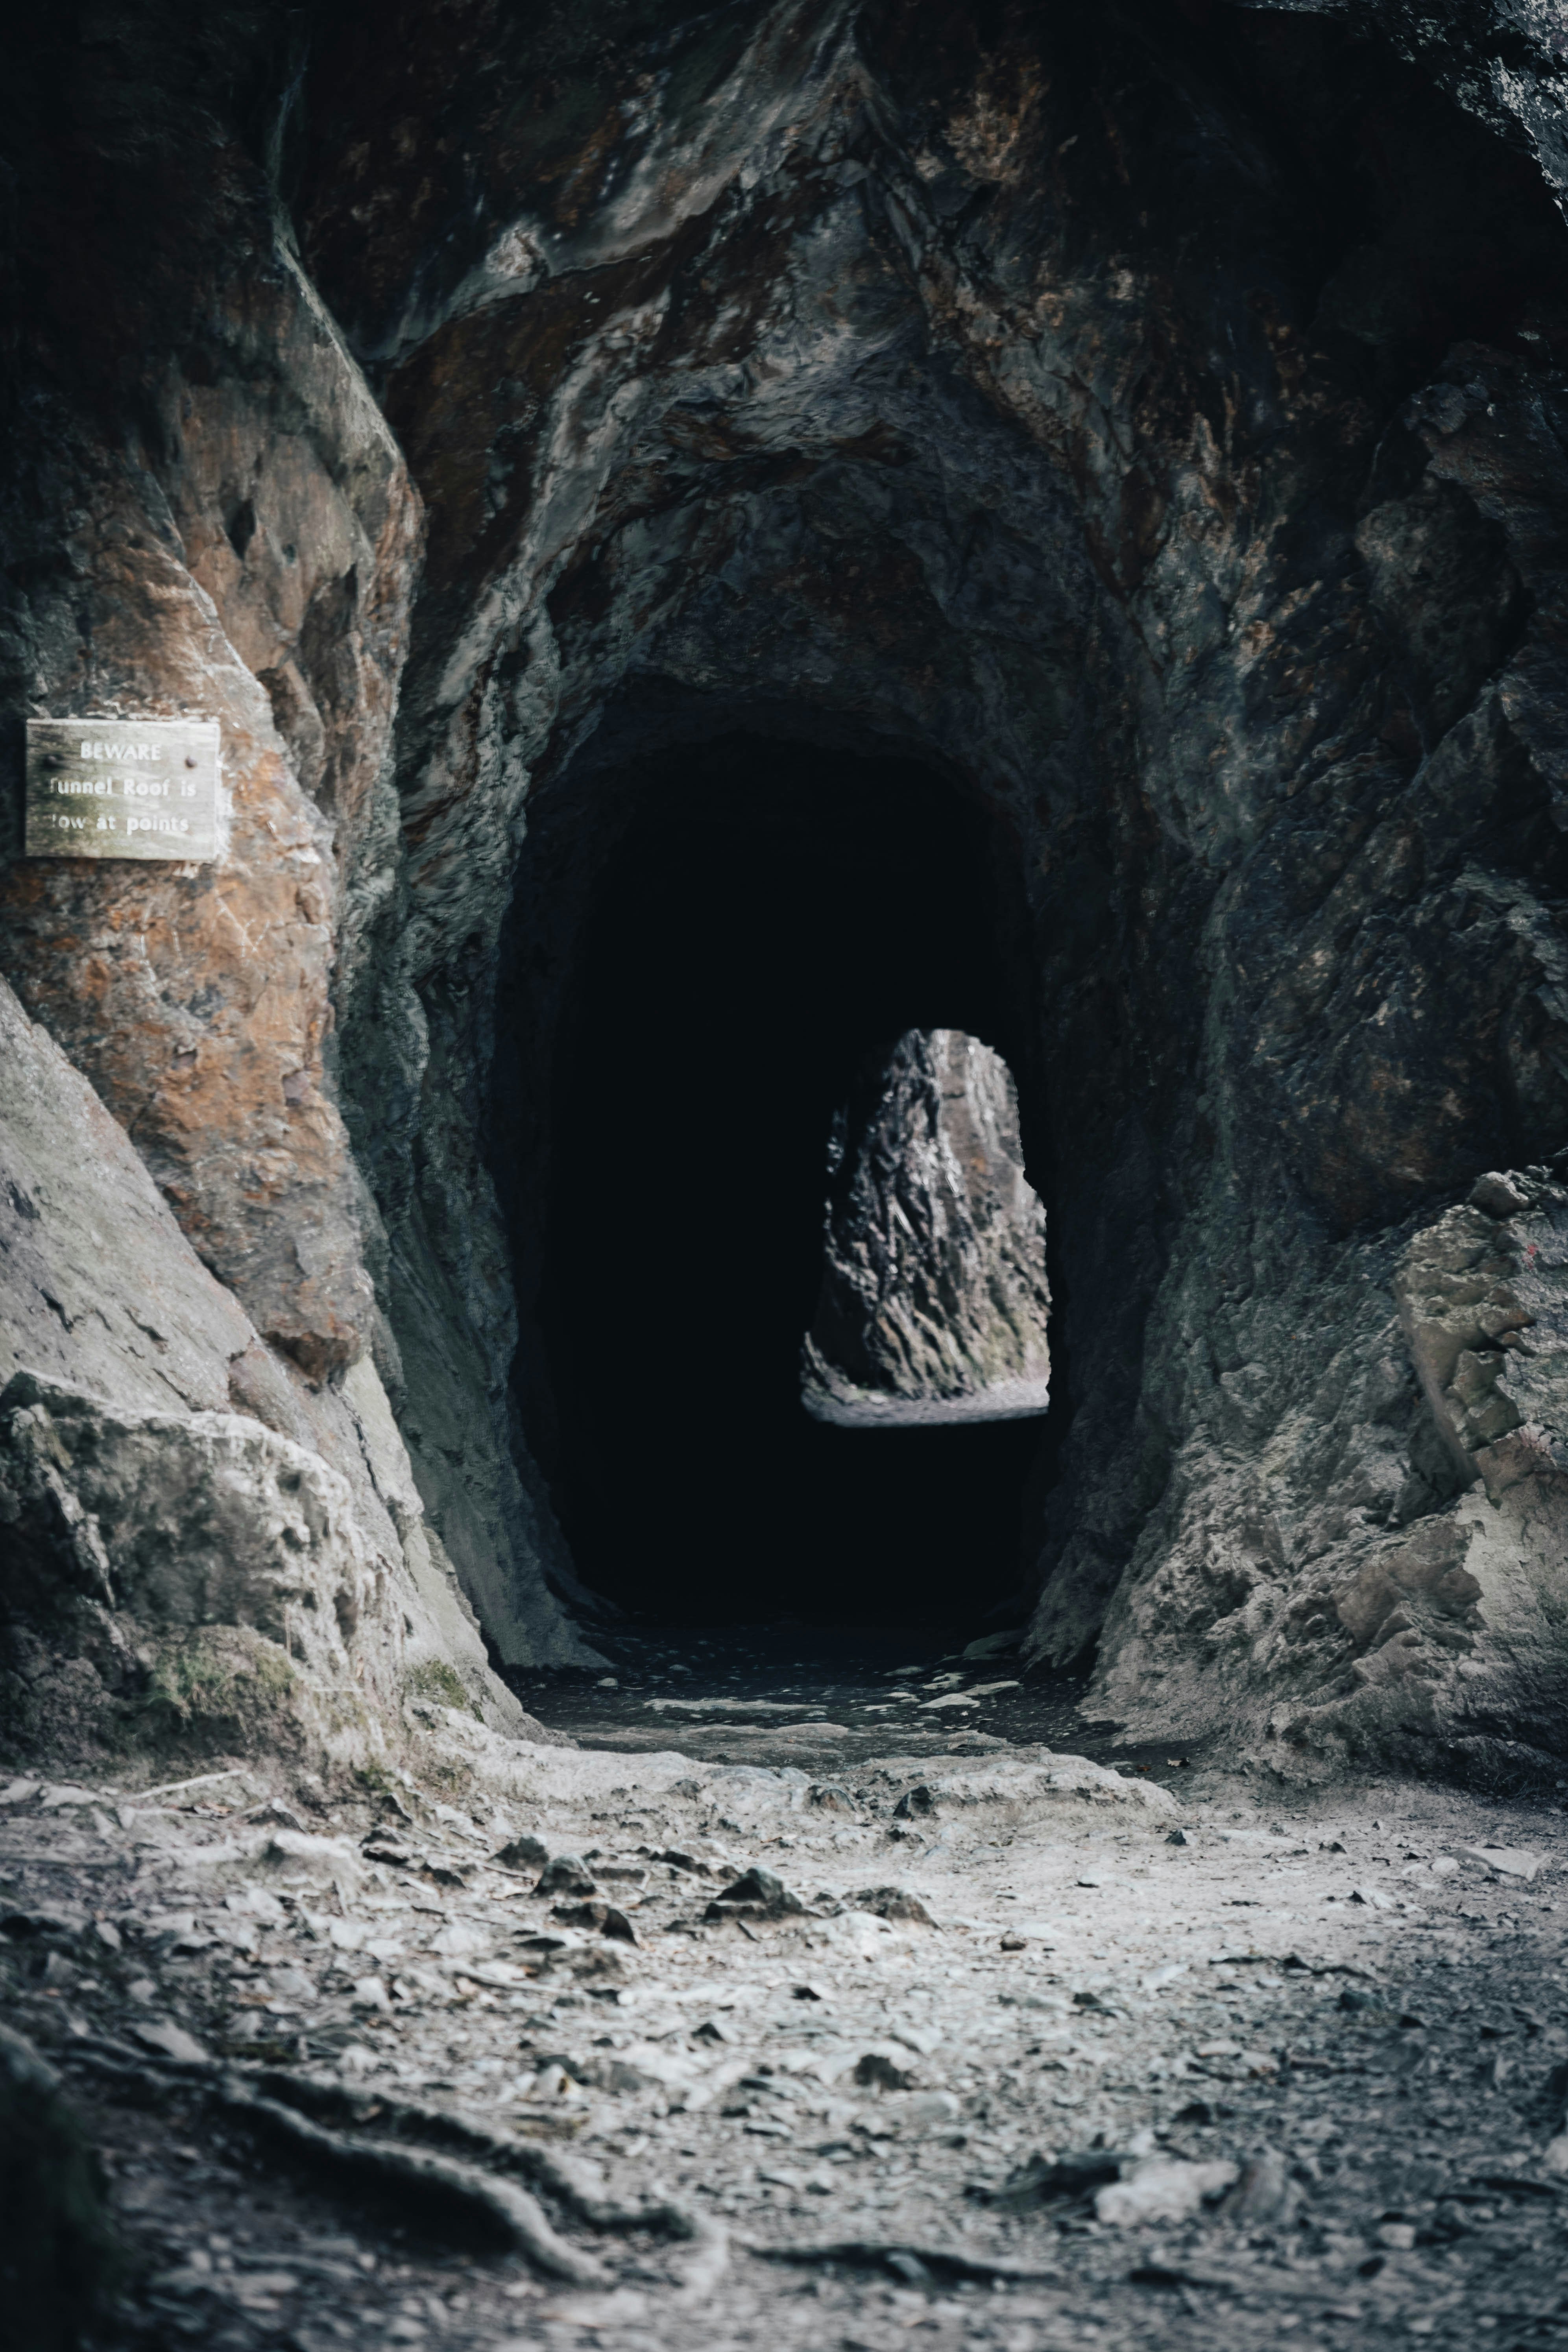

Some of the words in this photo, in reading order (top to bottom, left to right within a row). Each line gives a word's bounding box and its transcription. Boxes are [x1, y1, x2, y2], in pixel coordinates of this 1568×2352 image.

[81, 742, 161, 760] BEWARE
[123, 778, 170, 796] Roof
[181, 780, 196, 797] is
[96, 815, 116, 830] at
[126, 815, 189, 835] points
